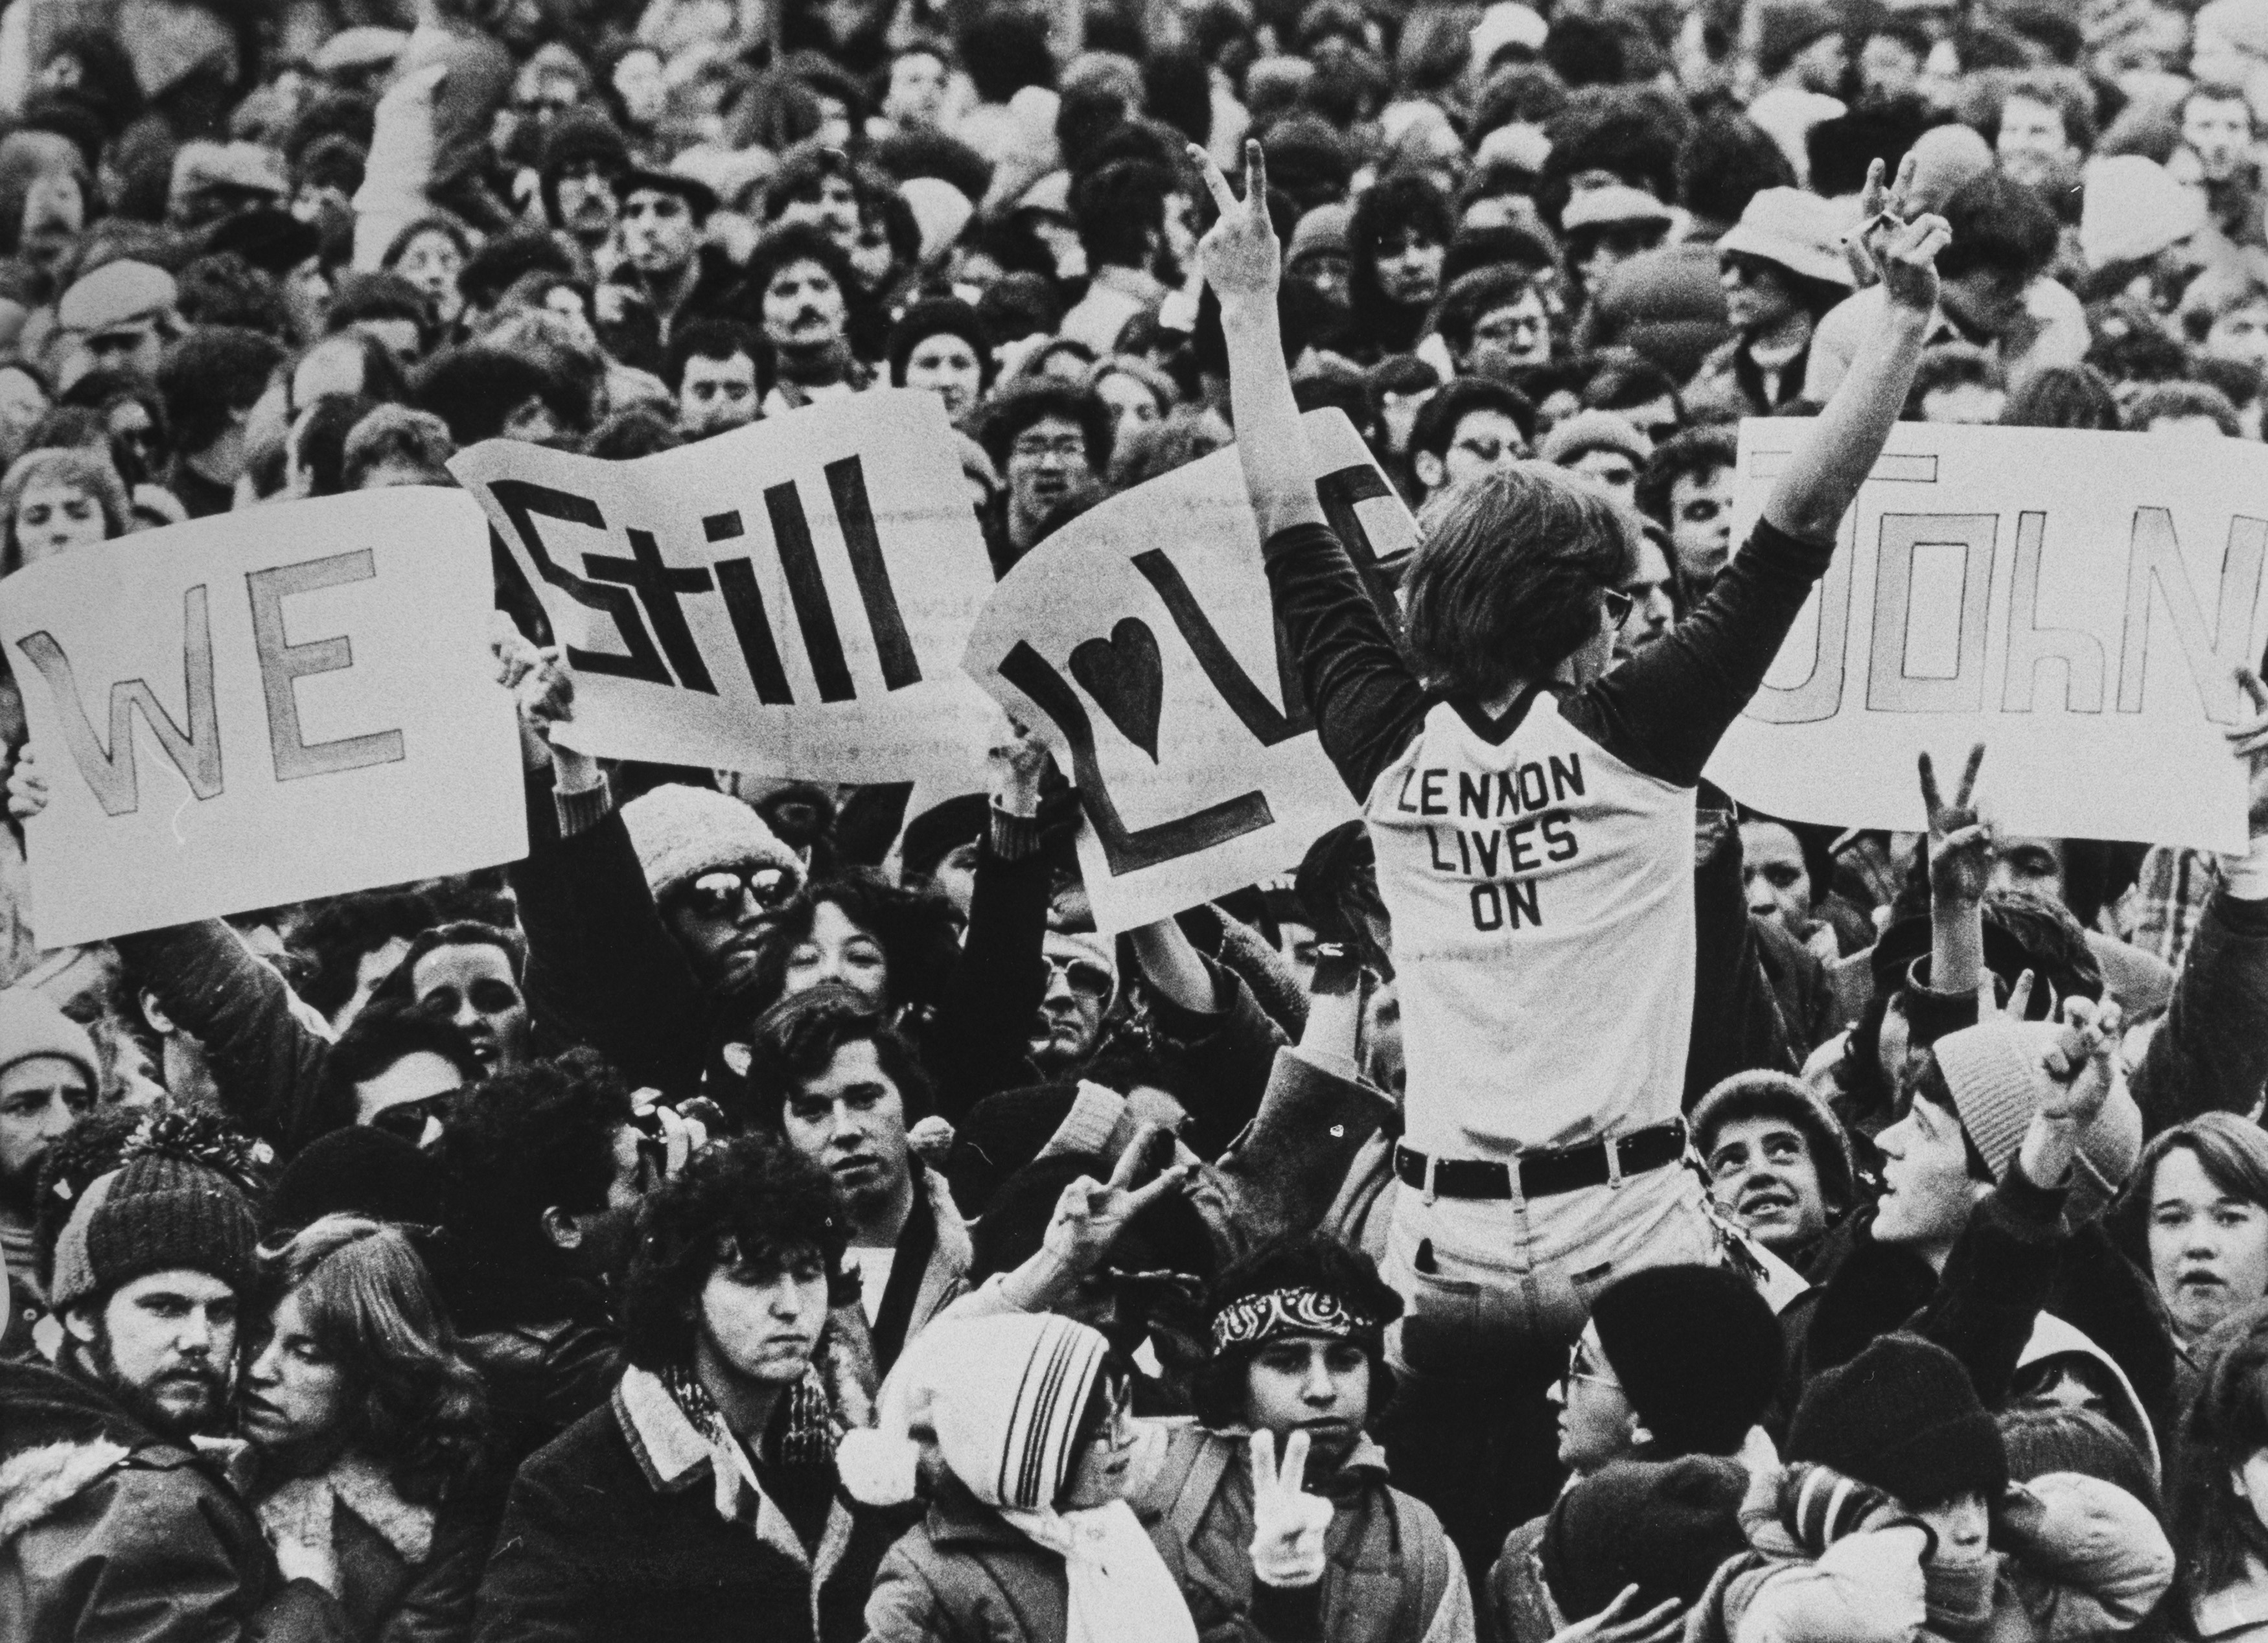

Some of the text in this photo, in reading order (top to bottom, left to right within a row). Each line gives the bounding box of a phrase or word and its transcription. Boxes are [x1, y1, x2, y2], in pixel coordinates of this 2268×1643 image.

[486, 454, 923, 706] Still
[16, 547, 406, 817] WE
[1398, 752, 1586, 820] LENNON
[1427, 809, 1579, 877] LIVES
[1470, 879, 1542, 932] ON
